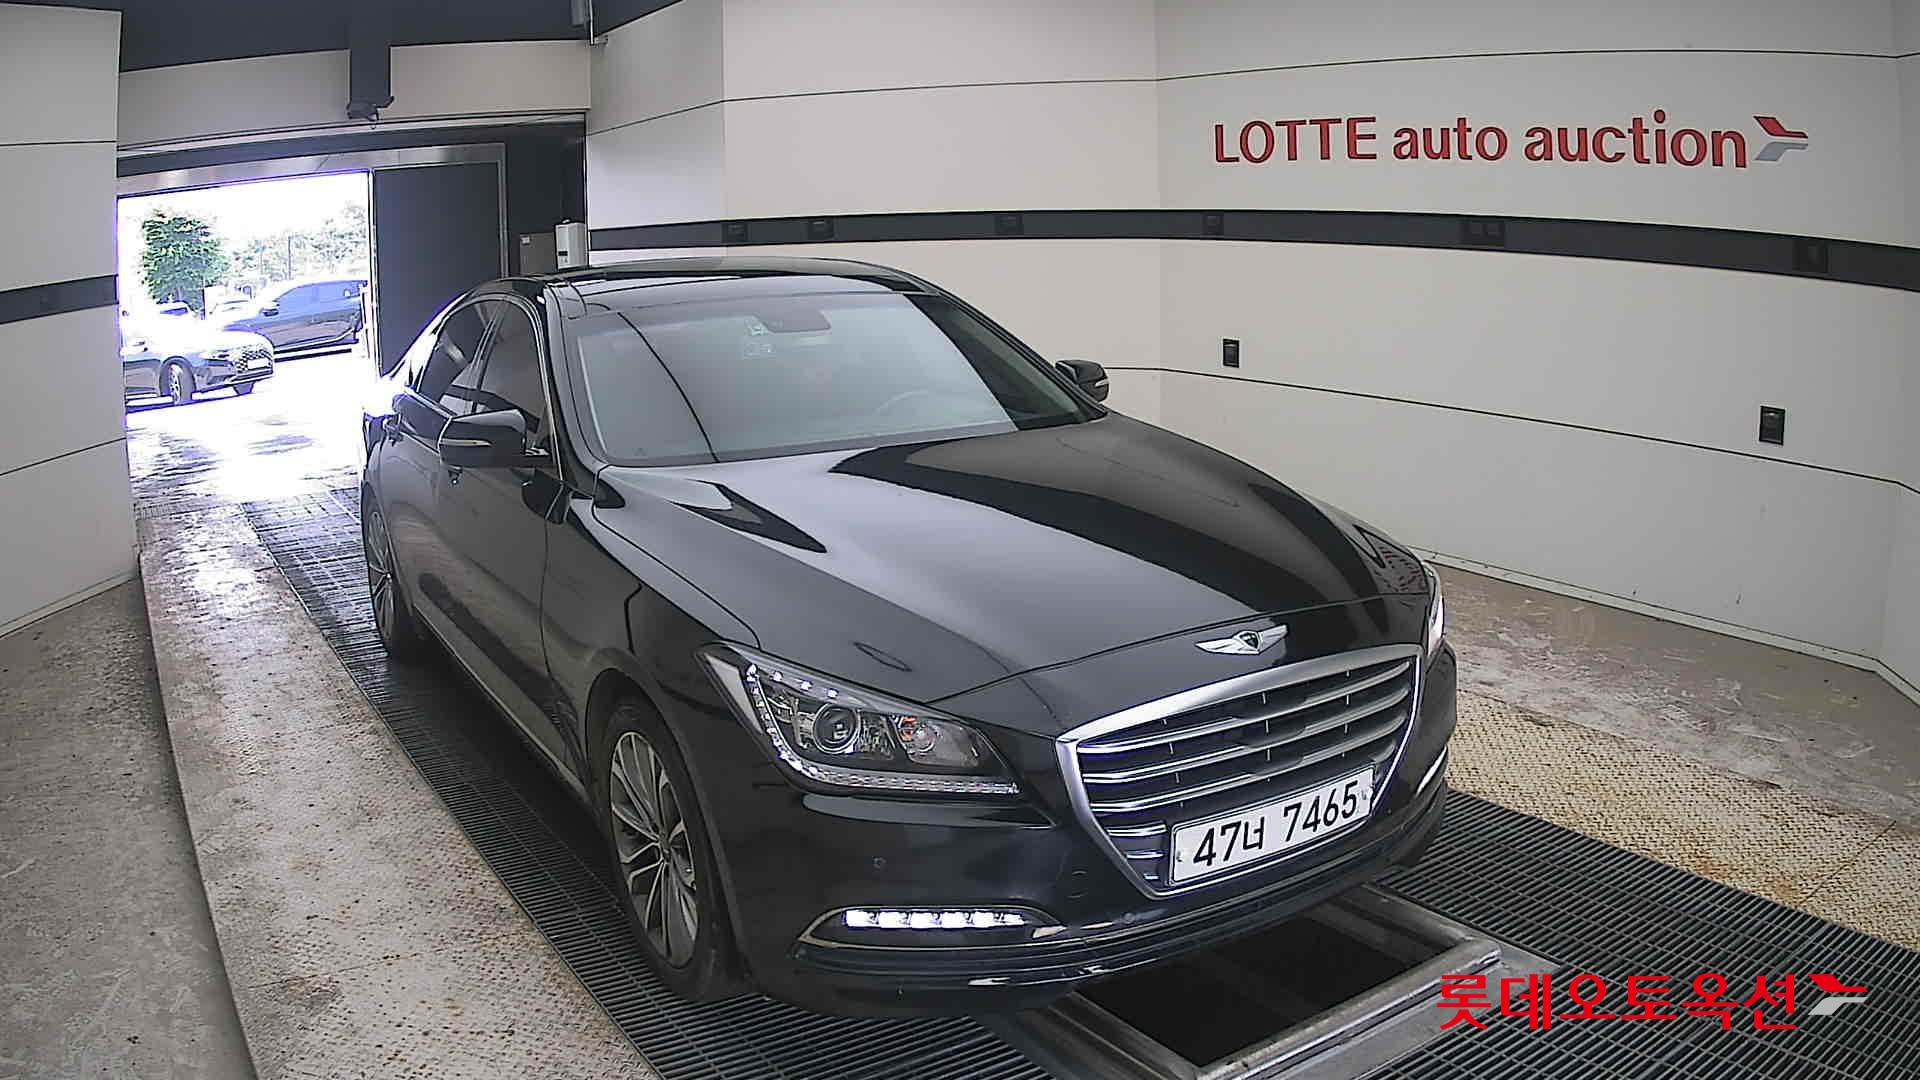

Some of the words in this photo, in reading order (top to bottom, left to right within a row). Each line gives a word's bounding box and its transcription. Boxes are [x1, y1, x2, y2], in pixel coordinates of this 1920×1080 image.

[1214, 115, 1378, 163] LOTTE
[1392, 116, 1509, 162] auto
[1523, 109, 1748, 169] auction
[1193, 816, 1265, 867] 47너
[1283, 780, 1359, 843] 7465
